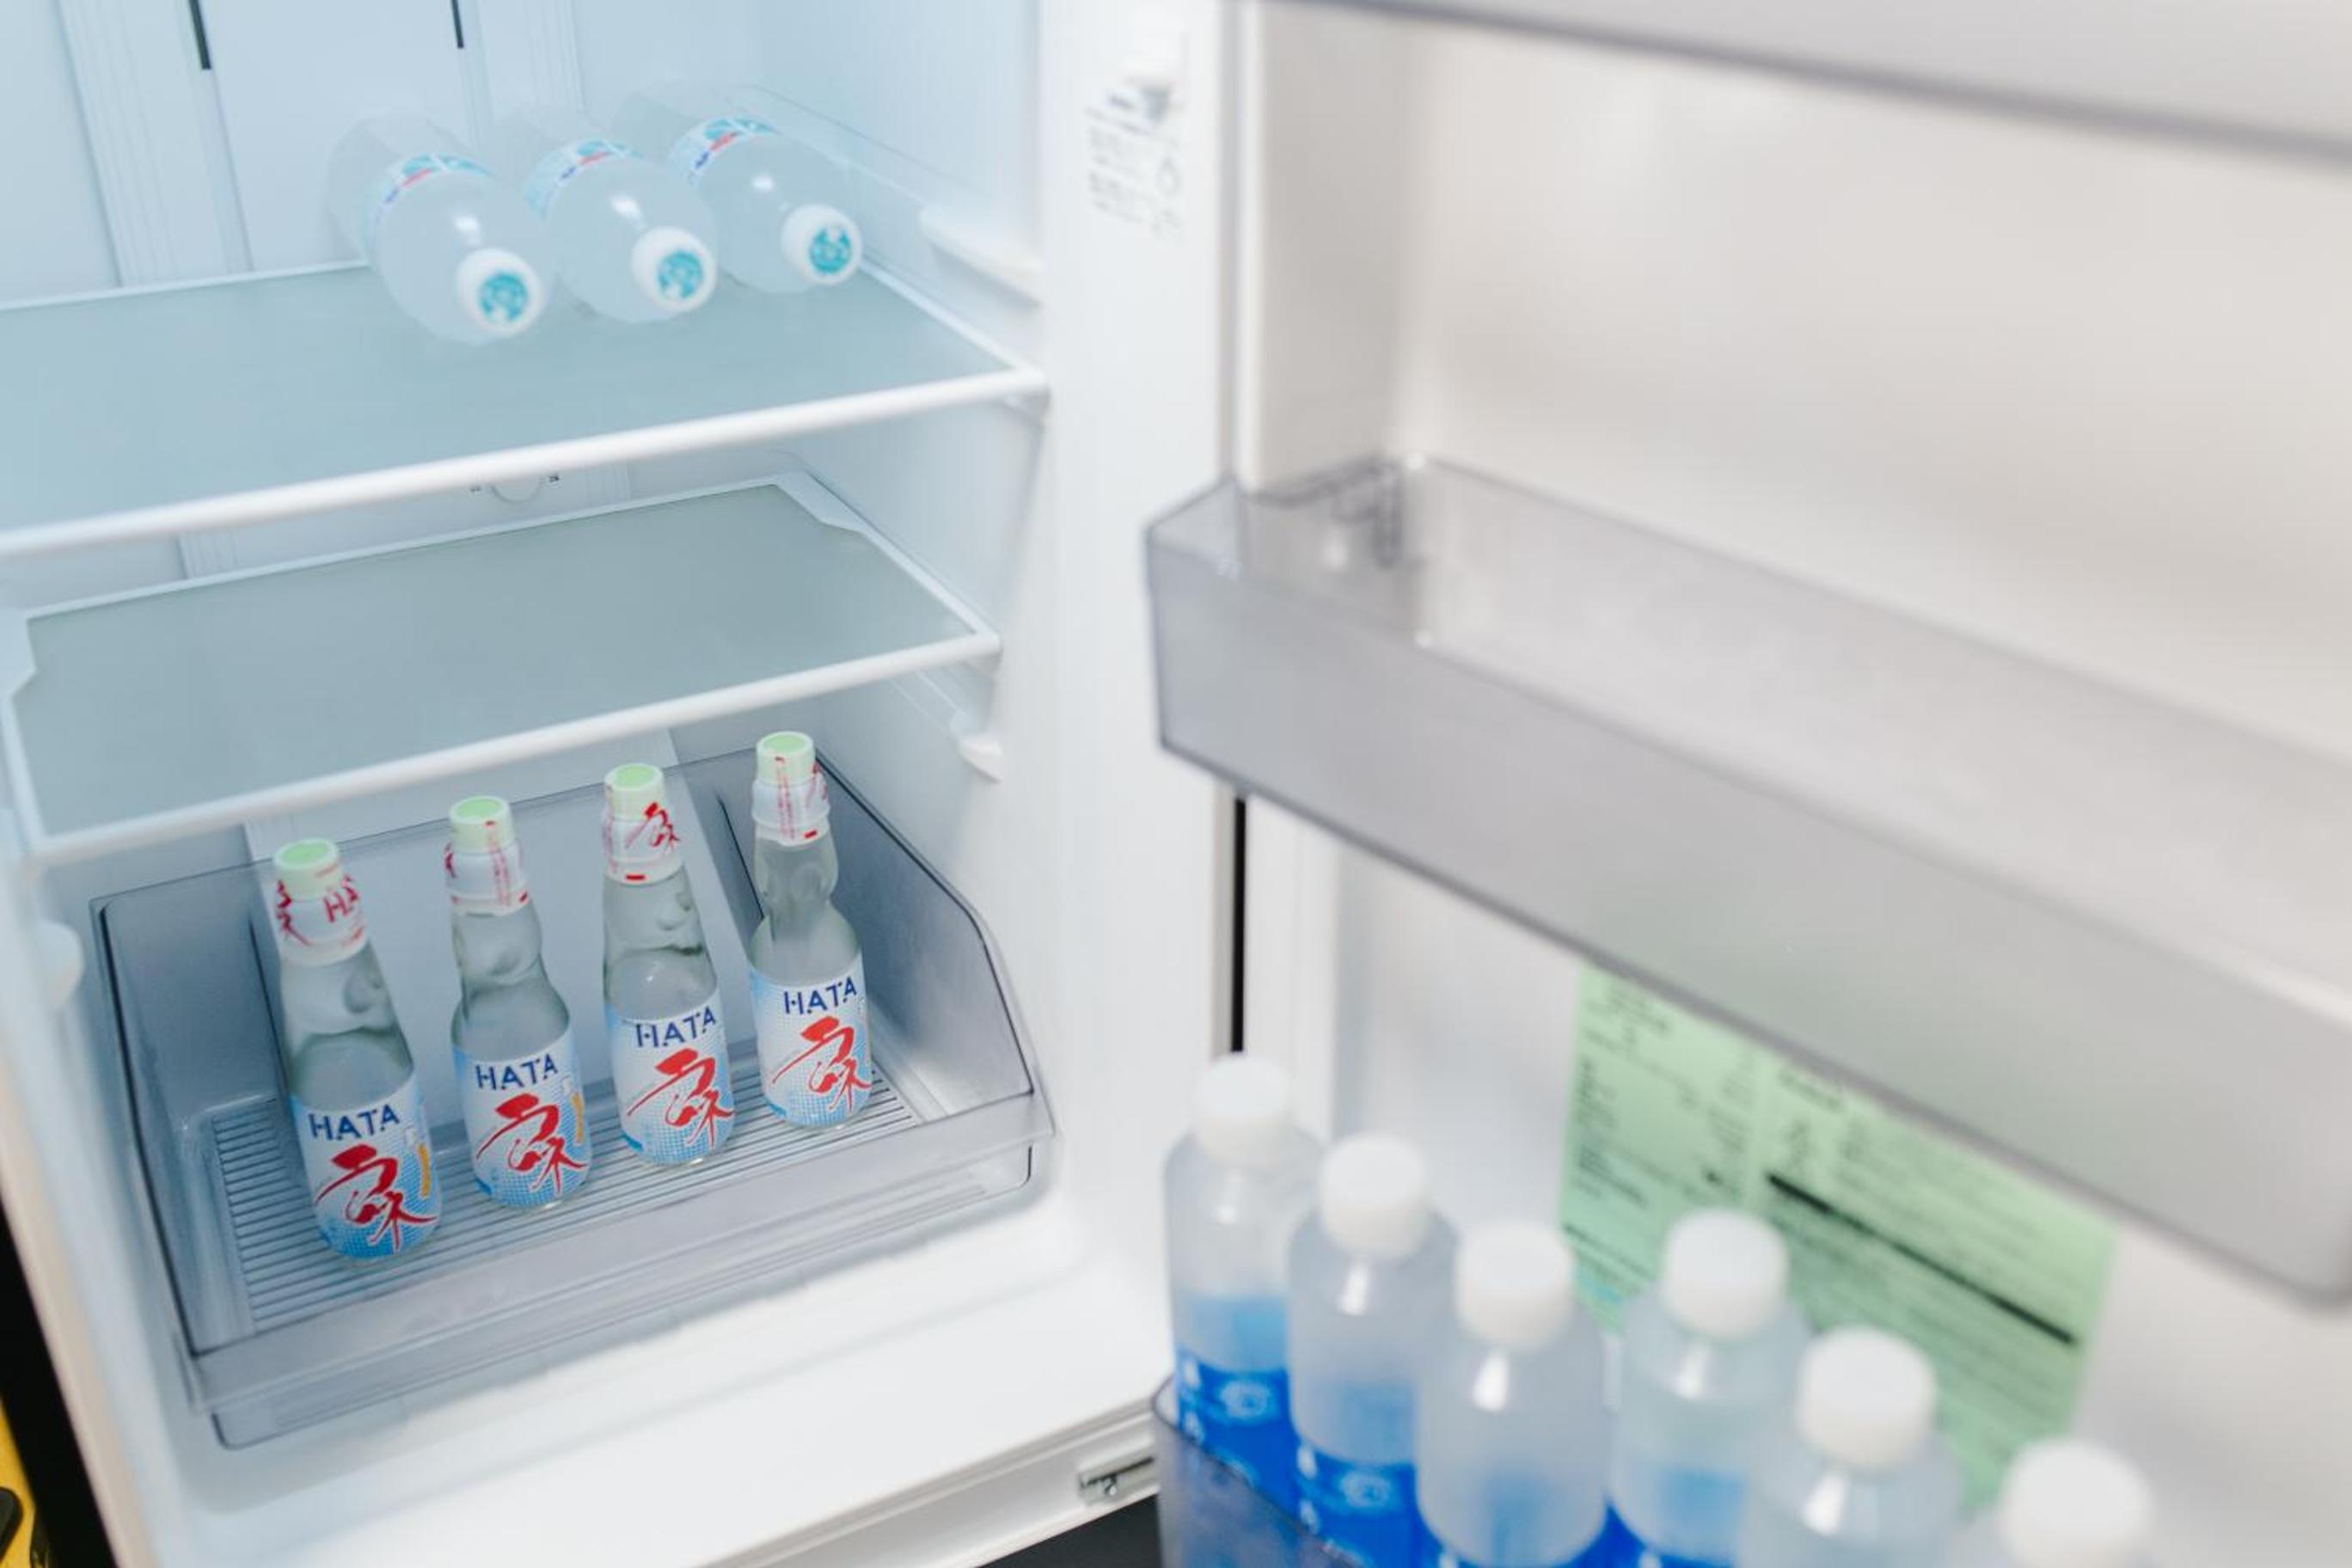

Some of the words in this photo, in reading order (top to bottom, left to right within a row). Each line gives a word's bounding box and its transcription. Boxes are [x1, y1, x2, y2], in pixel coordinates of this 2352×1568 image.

[783, 976, 857, 1015] HATA
[634, 1006, 716, 1048] HATA
[475, 1053, 559, 1090] HATA
[308, 1104, 401, 1141] HATA
